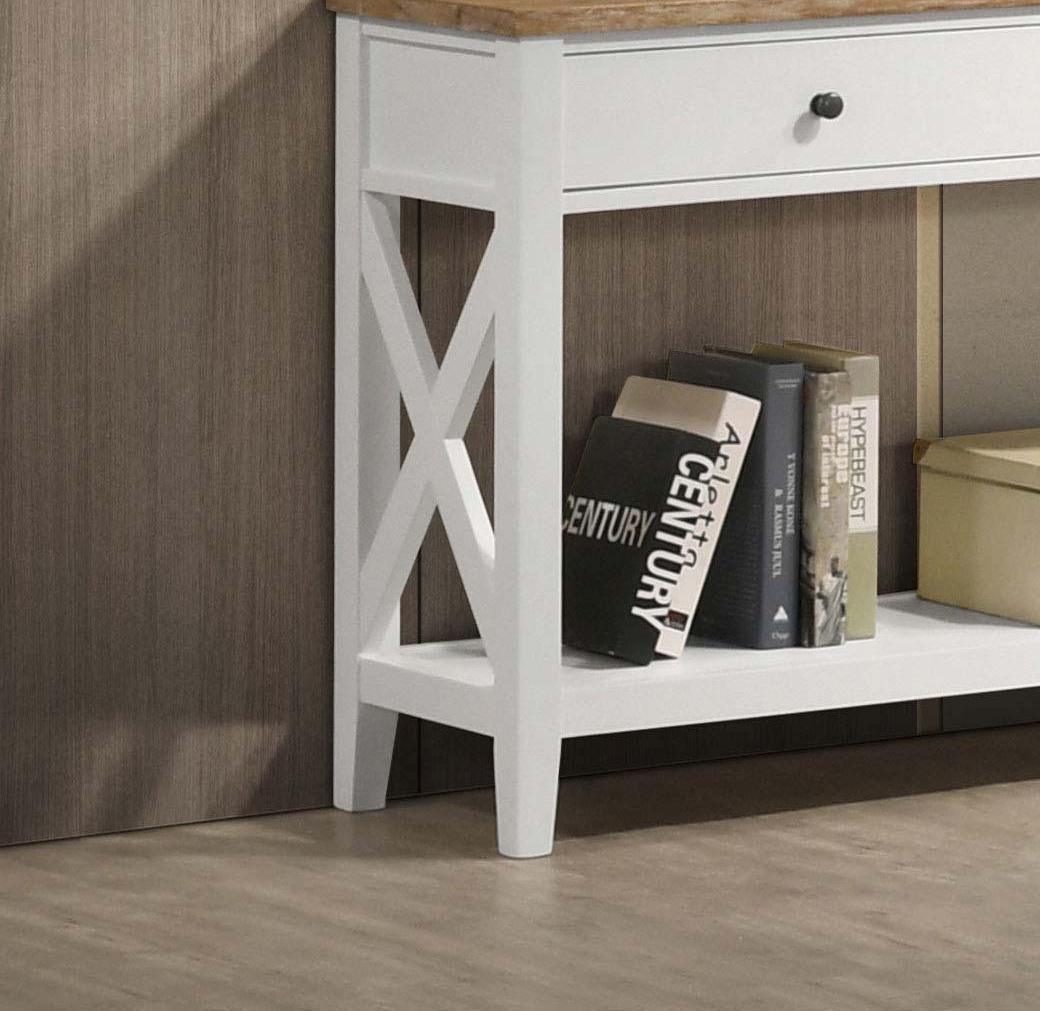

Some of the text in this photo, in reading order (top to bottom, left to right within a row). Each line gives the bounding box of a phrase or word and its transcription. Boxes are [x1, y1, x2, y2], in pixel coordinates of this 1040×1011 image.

[836, 404, 849, 484] Europe
[850, 406, 867, 521] HYPEBEAST
[631, 453, 716, 633] CENTURY
